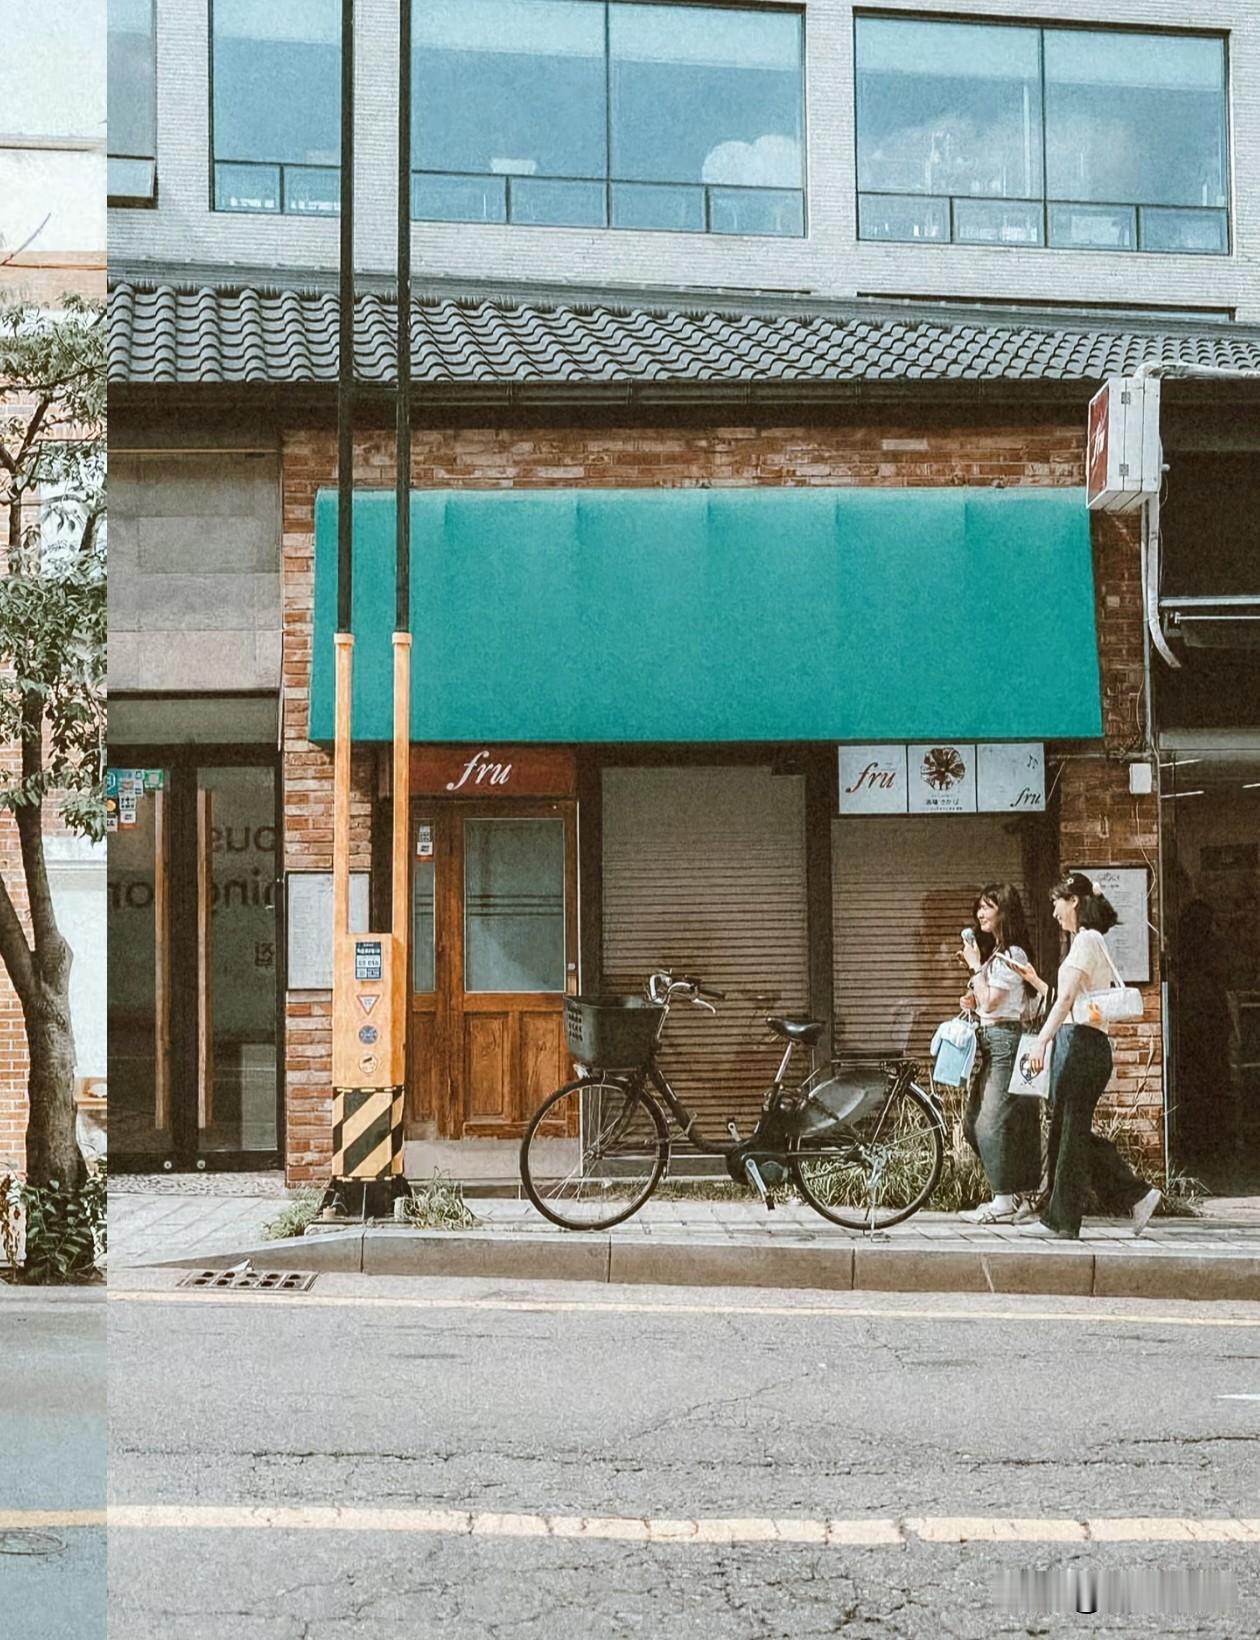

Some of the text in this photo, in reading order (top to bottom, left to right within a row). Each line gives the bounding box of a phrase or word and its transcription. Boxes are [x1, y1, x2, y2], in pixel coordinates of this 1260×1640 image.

[446, 750, 512, 790] fru
[845, 762, 896, 794] fru
[1010, 788, 1042, 808] fru
